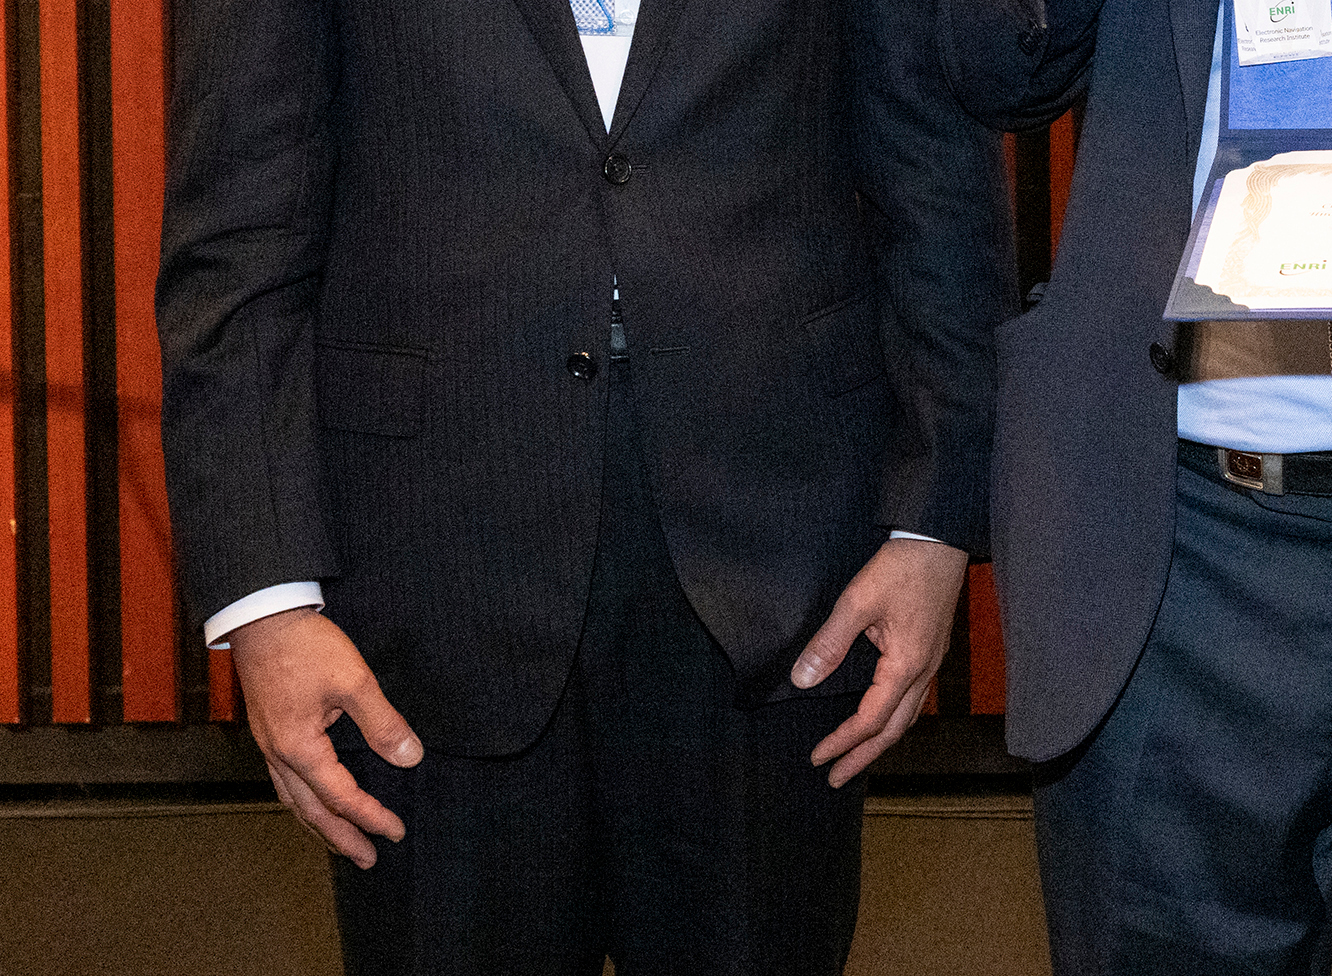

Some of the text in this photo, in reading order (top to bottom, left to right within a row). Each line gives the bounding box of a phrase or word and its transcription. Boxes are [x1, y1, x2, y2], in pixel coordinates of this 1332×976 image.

[1255, 25, 1314, 36] Electronic Navigation
[1260, 35, 1286, 43] Research
[1286, 33, 1311, 41] Institute
